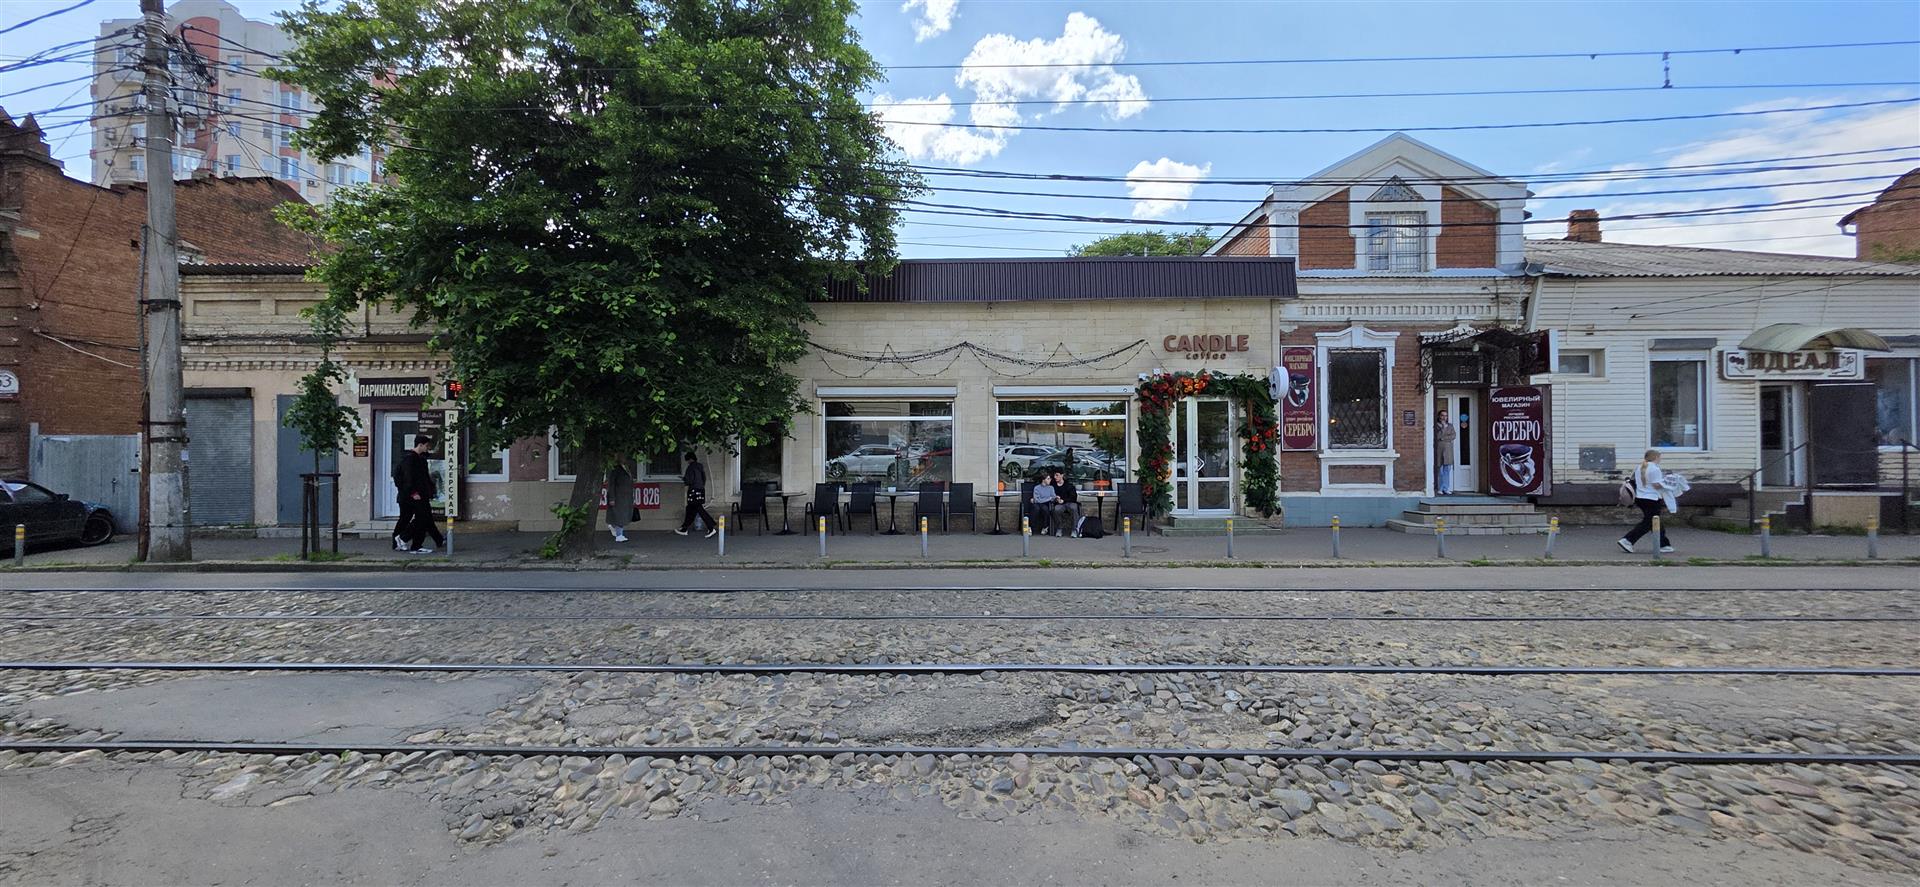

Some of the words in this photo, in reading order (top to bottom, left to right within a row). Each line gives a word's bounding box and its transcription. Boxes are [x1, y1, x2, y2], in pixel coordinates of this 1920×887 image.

[1163, 334, 1250, 352] CANDLE
[1185, 351, 1227, 360] coffee
[1748, 352, 1840, 372] ИДЕАЛ
[0, 374, 12, 388] 3
[360, 383, 429, 397] ПАРИКМАХЕРСКАЯ
[1491, 395, 1541, 403] ЮВЕЛИРНЫЙ
[1284, 423, 1315, 437] СЕРЕБРО
[1492, 420, 1541, 441] СЕРЕБРО
[643, 488, 660, 505] 826
